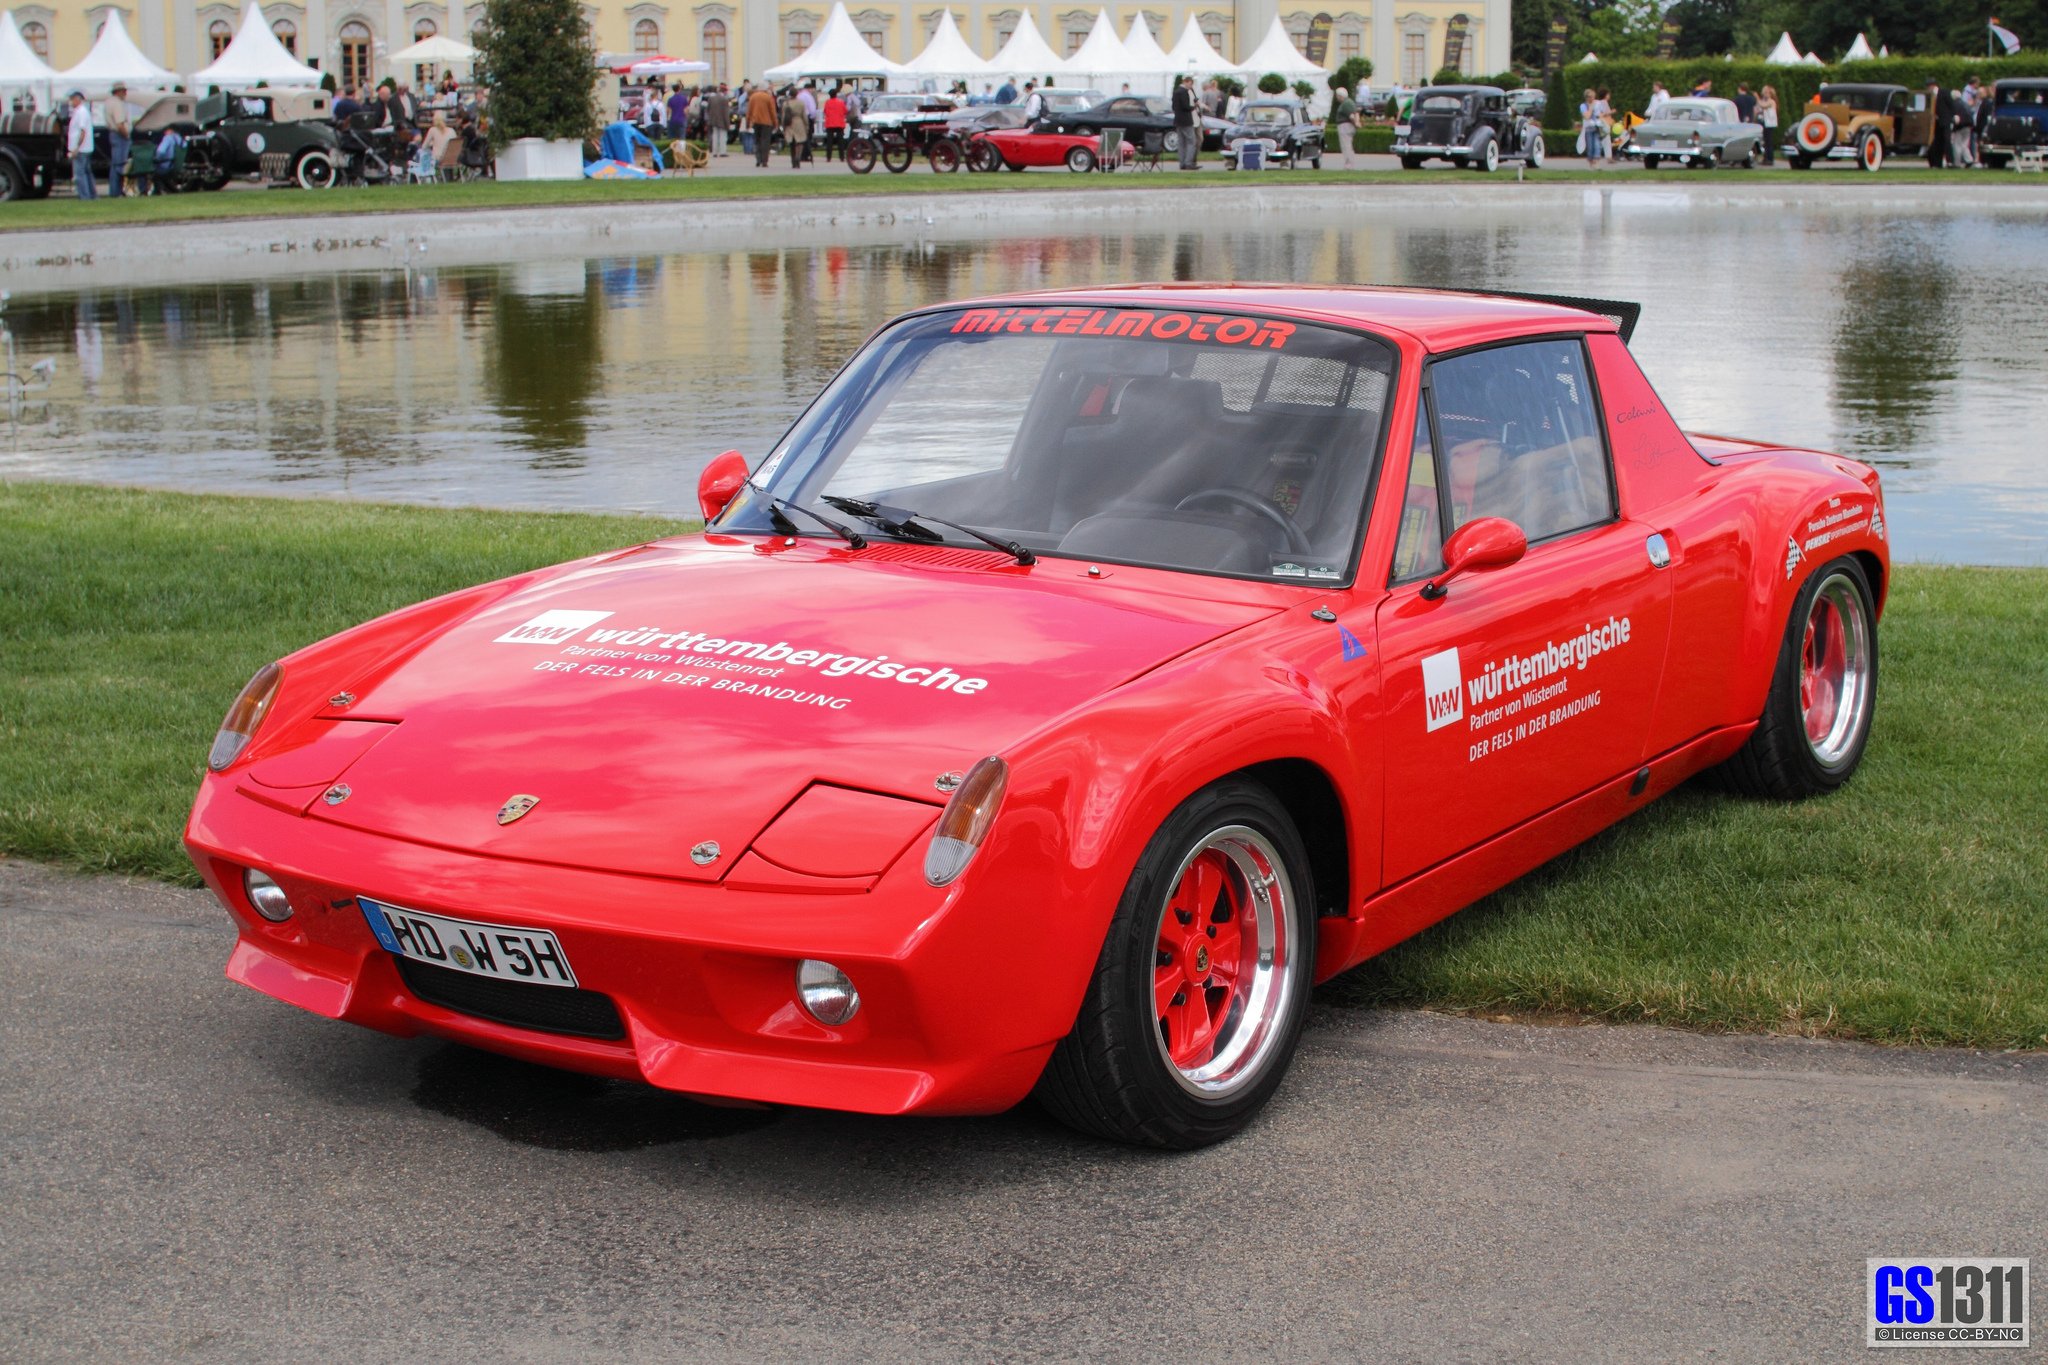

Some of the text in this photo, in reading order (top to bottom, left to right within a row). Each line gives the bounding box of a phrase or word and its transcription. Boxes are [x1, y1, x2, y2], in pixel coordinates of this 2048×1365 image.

[533, 660, 852, 710] DER FELS IN DER BRANDUNG
[560, 645, 785, 678] Partner von Wüstenrot
[584, 626, 989, 696] württembergische
[1467, 615, 1631, 706] württembergische
[1469, 689, 1601, 763] DER FELS IN DER BRANDUNG
[1470, 676, 1568, 732] Partner von Wüstenrot
[381, 932, 391, 944] D
[384, 911, 569, 981] HD W 5H
